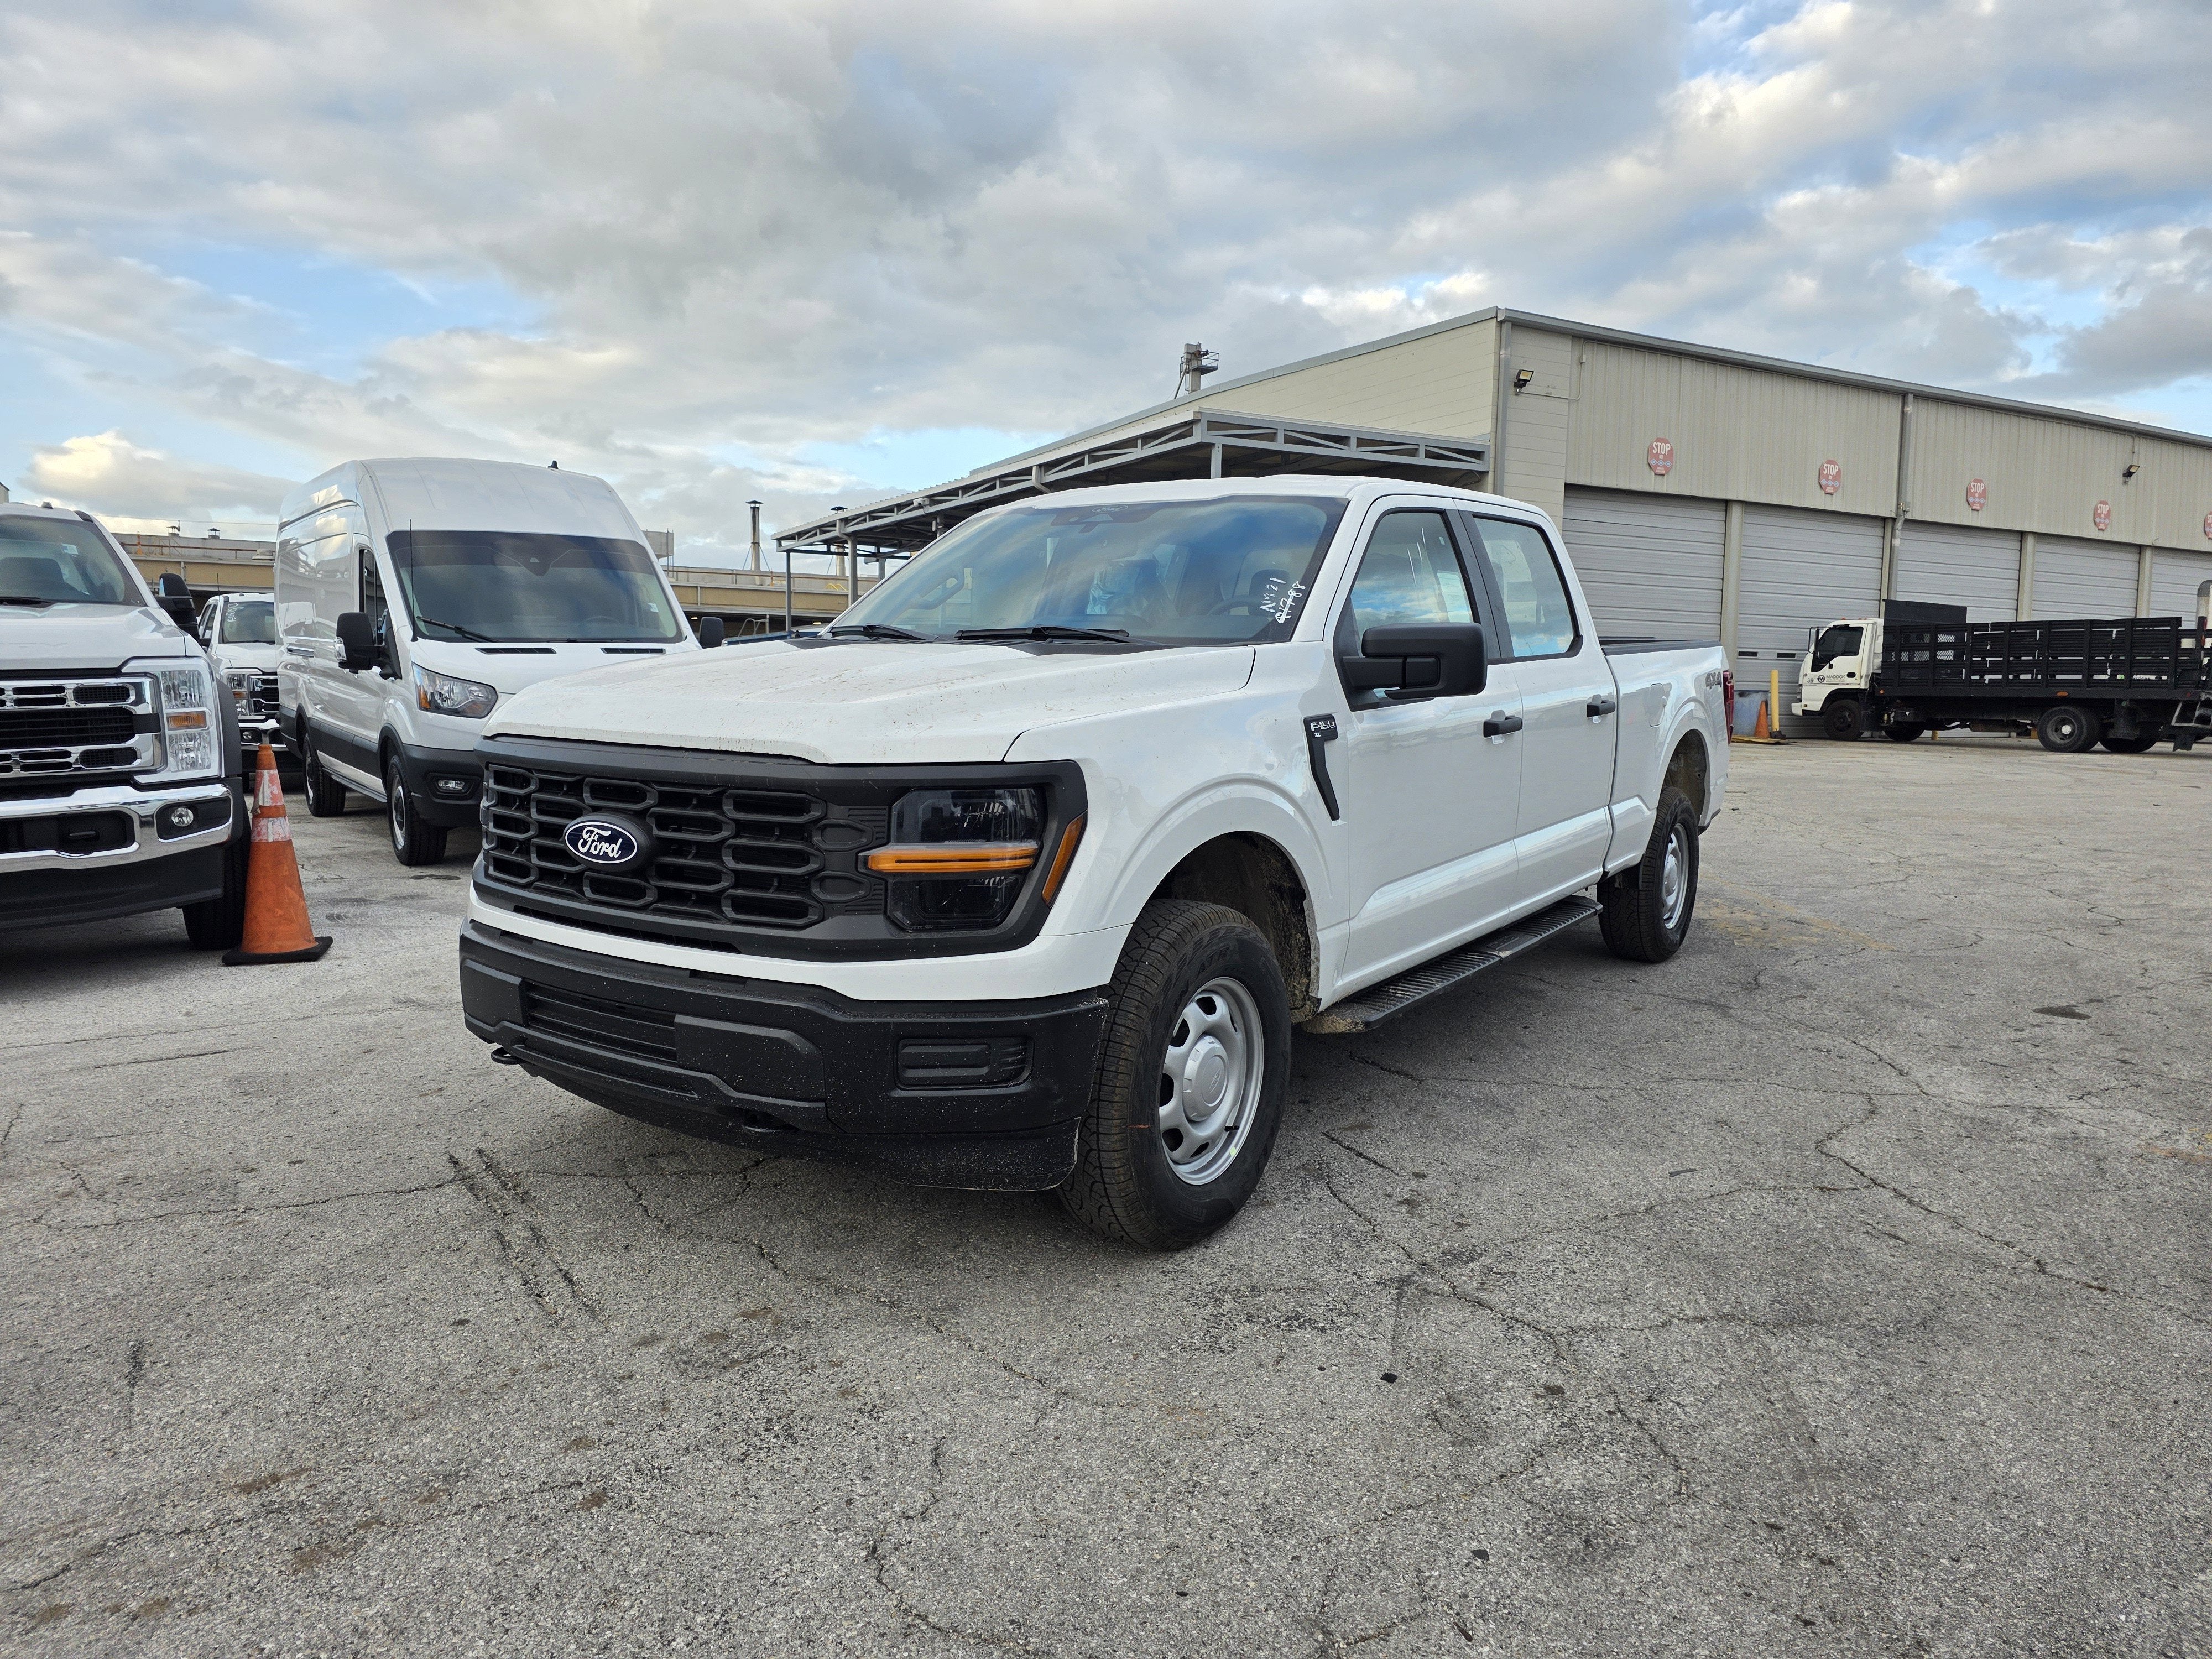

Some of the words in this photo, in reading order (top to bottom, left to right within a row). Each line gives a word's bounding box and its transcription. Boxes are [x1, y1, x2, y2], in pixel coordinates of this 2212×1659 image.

[1652, 441, 1671, 455] STOP
[1823, 463, 1839, 476] STOP
[1970, 482, 1985, 493] STOP
[2097, 504, 2110, 514] STOP
[578, 827, 623, 858] Ford
